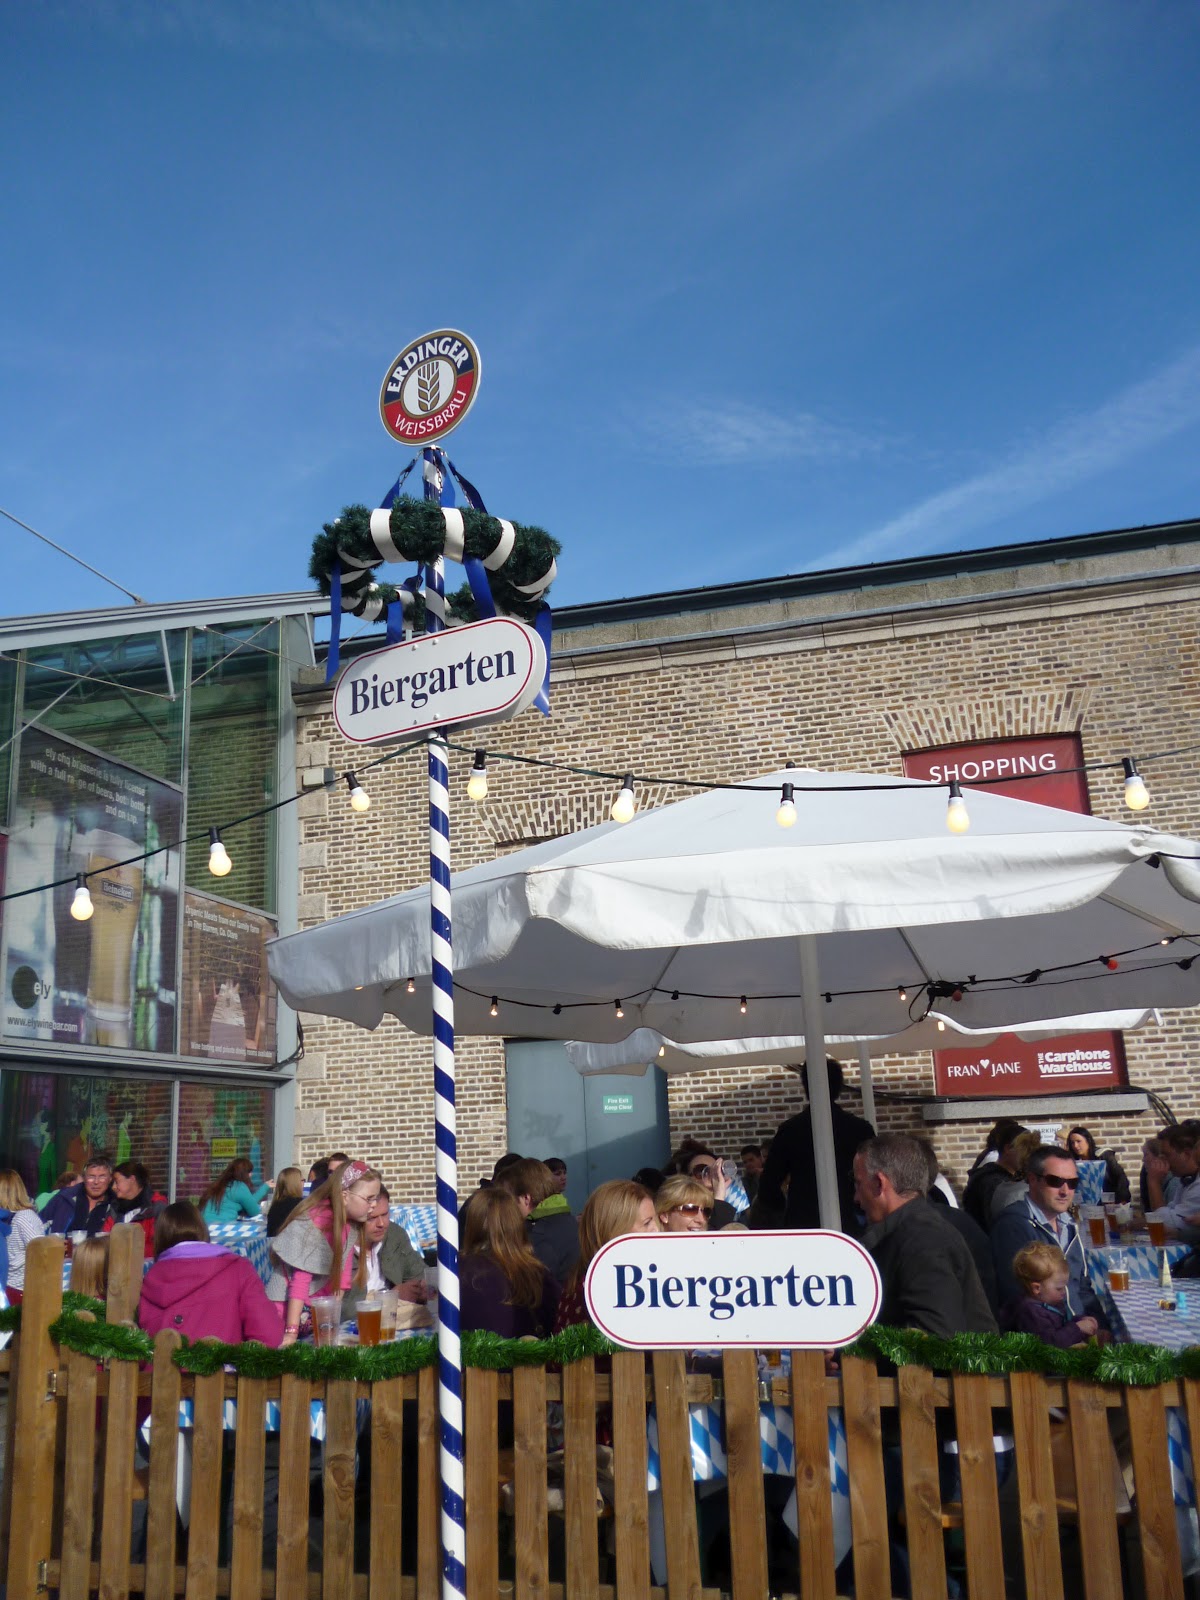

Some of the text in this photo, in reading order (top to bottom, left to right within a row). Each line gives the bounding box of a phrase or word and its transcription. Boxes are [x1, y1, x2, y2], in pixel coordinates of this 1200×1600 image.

[387, 337, 469, 393] ERDINGER
[395, 390, 466, 435] WEISSBRÄU
[350, 650, 516, 716] Biergarten
[30, 759, 46, 774] with
[47, 766, 53, 776] a
[54, 767, 67, 782] full
[67, 774, 87, 790] rage
[929, 753, 1057, 783] SHOPPING
[105, 804, 117, 816] and
[118, 810, 126, 820] on
[103, 881, 132, 898] Heineken
[33, 980, 51, 999] ely
[7, 1016, 78, 1033] www.elywinebar.com
[1045, 1050, 1110, 1063] Carphone
[947, 1062, 1021, 1078] FRAN JANE
[1039, 1060, 1112, 1074] Warehouse
[613, 1263, 857, 1320] Biergarten
